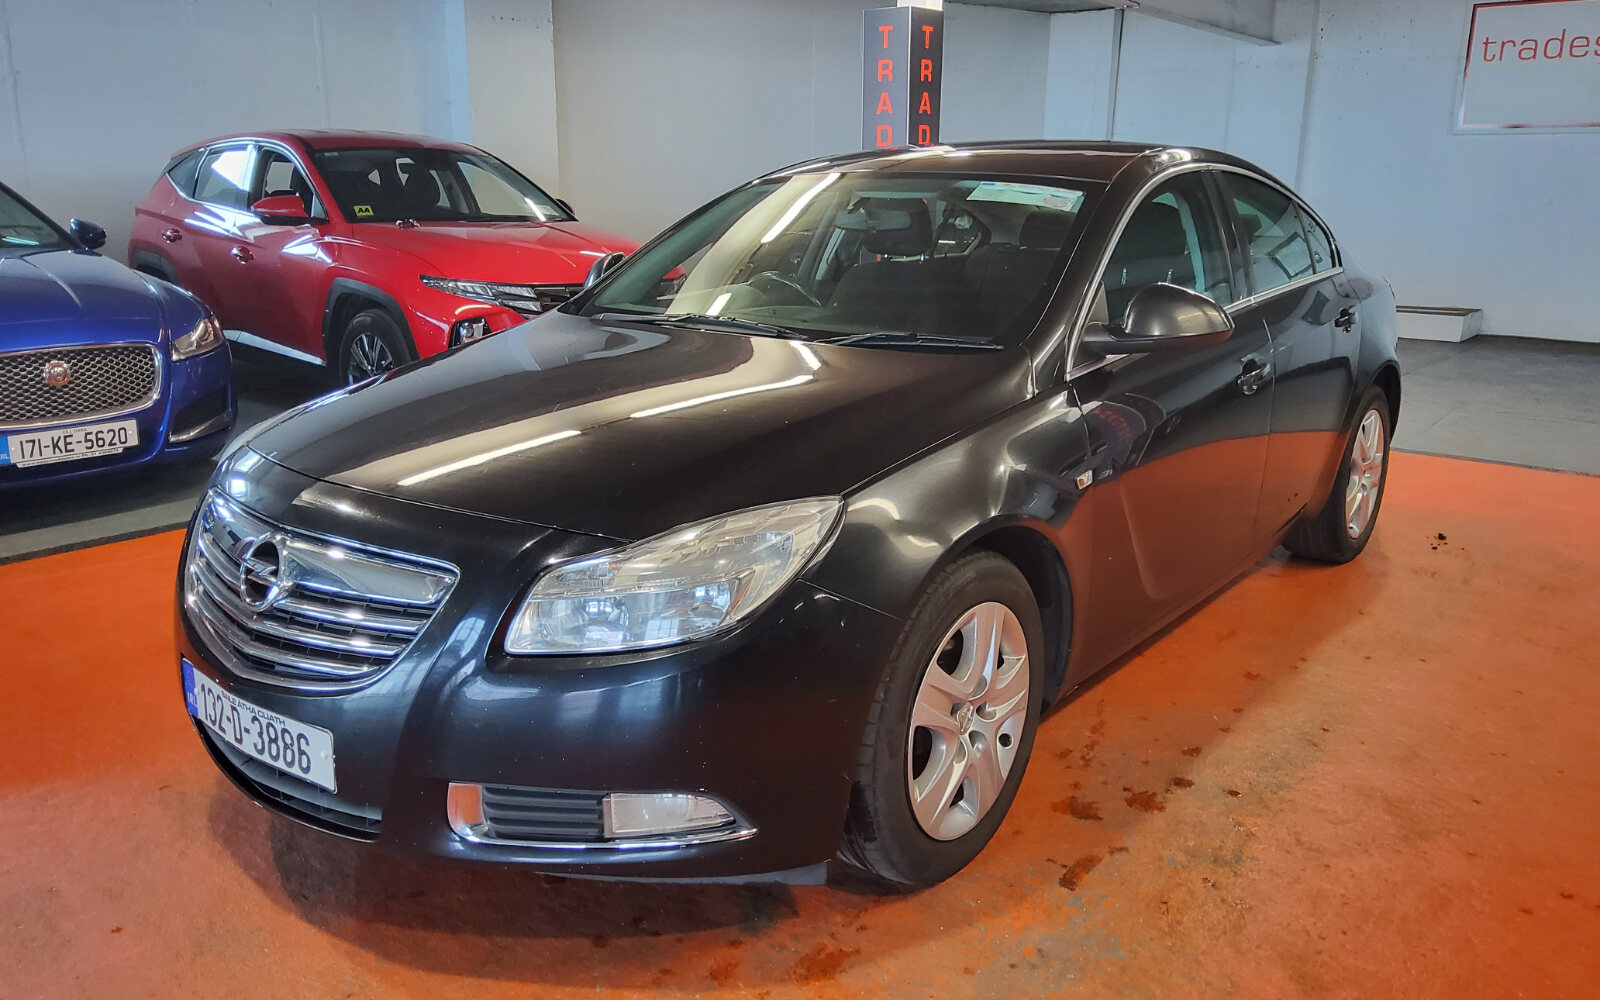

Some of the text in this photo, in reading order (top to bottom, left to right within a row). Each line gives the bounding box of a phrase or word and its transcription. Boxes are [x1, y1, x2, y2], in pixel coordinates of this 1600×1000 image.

[19, 427, 128, 460] 171-KE-5620
[200, 683, 312, 775] 132-D-3886
[257, 709, 286, 726] CLIATH
